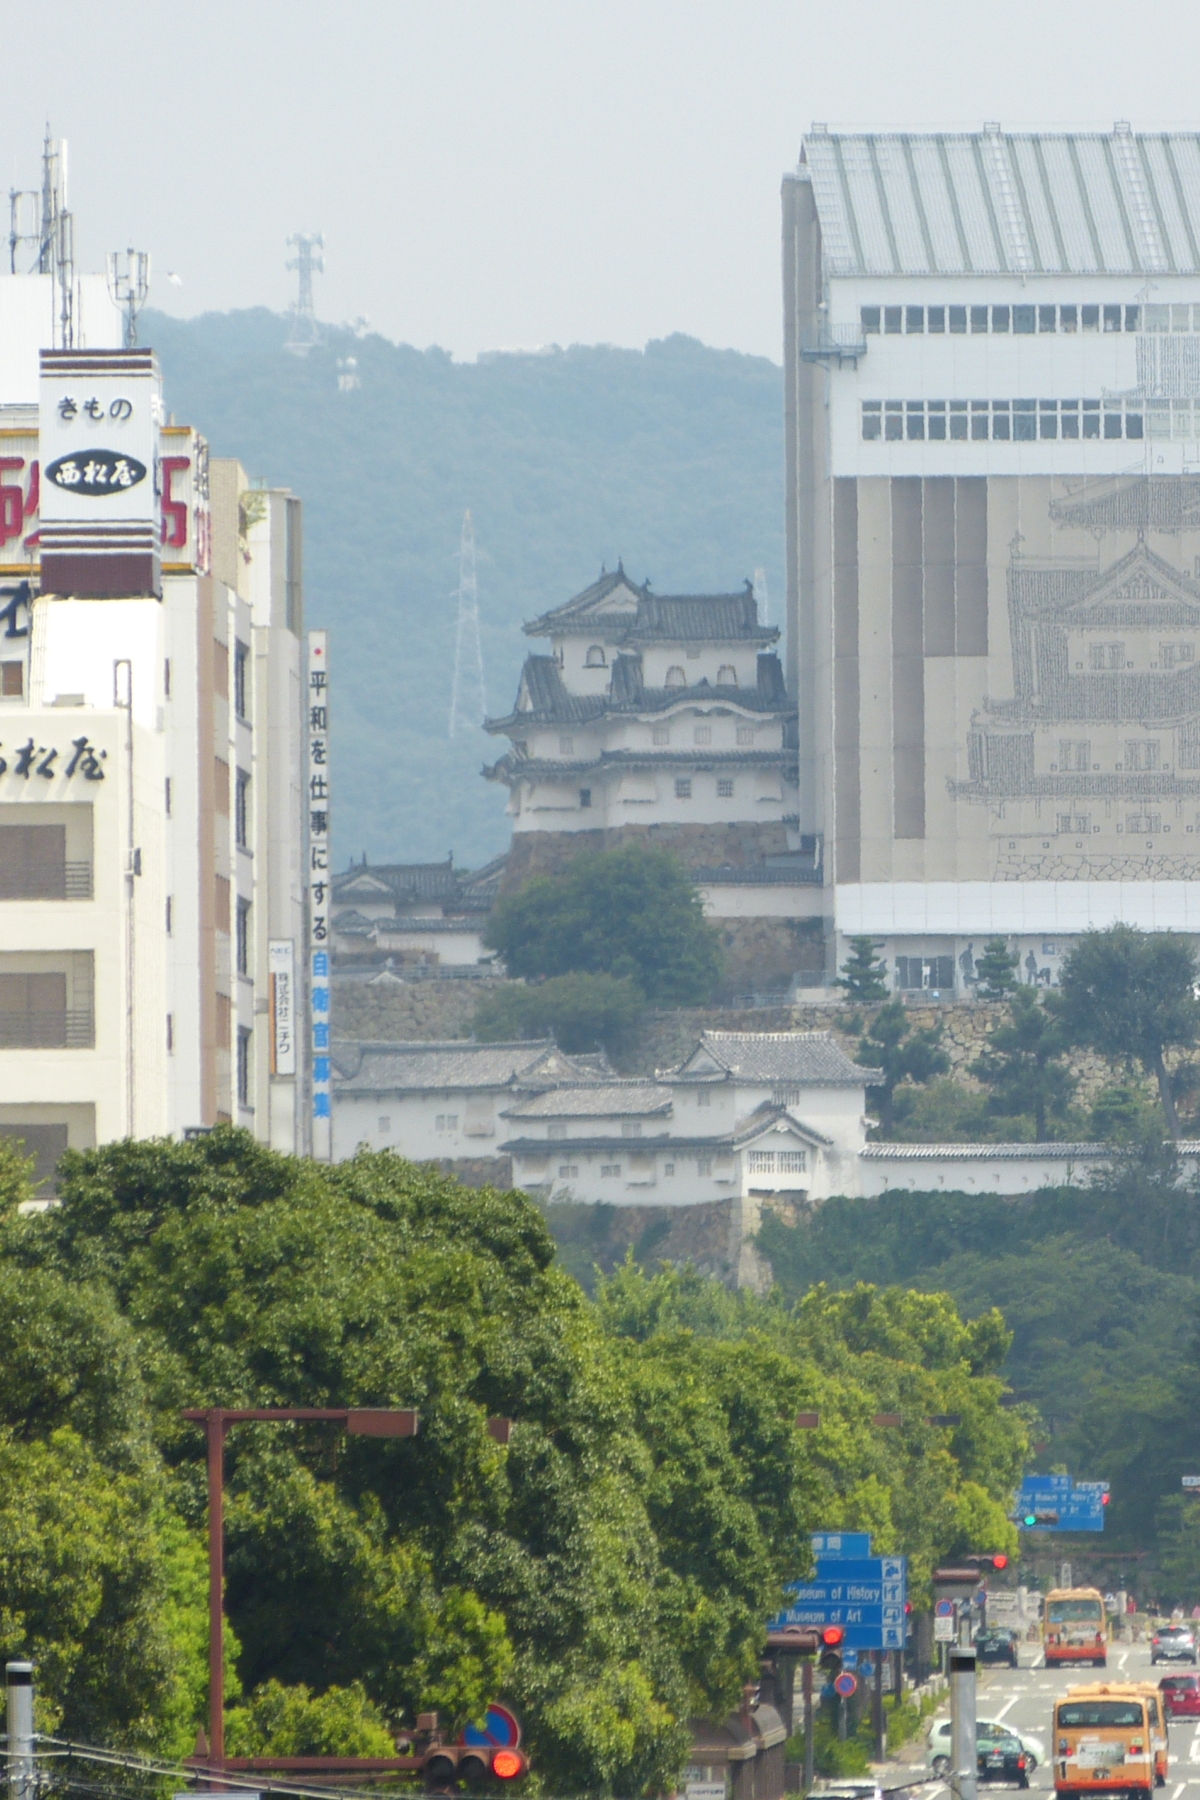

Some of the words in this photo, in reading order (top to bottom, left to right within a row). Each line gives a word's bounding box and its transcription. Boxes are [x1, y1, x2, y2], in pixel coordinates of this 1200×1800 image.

[58, 396, 133, 420] きもの
[55, 459, 137, 486] 西松屋
[309, 670, 328, 941] 平和を仕事にする
[311, 951, 331, 1119] 自衛官募集
[831, 1586, 843, 1600] of
[847, 1586, 880, 1603] History
[786, 1610, 825, 1623] Museum
[831, 1610, 841, 1622] of
[847, 1609, 862, 1623] Art
